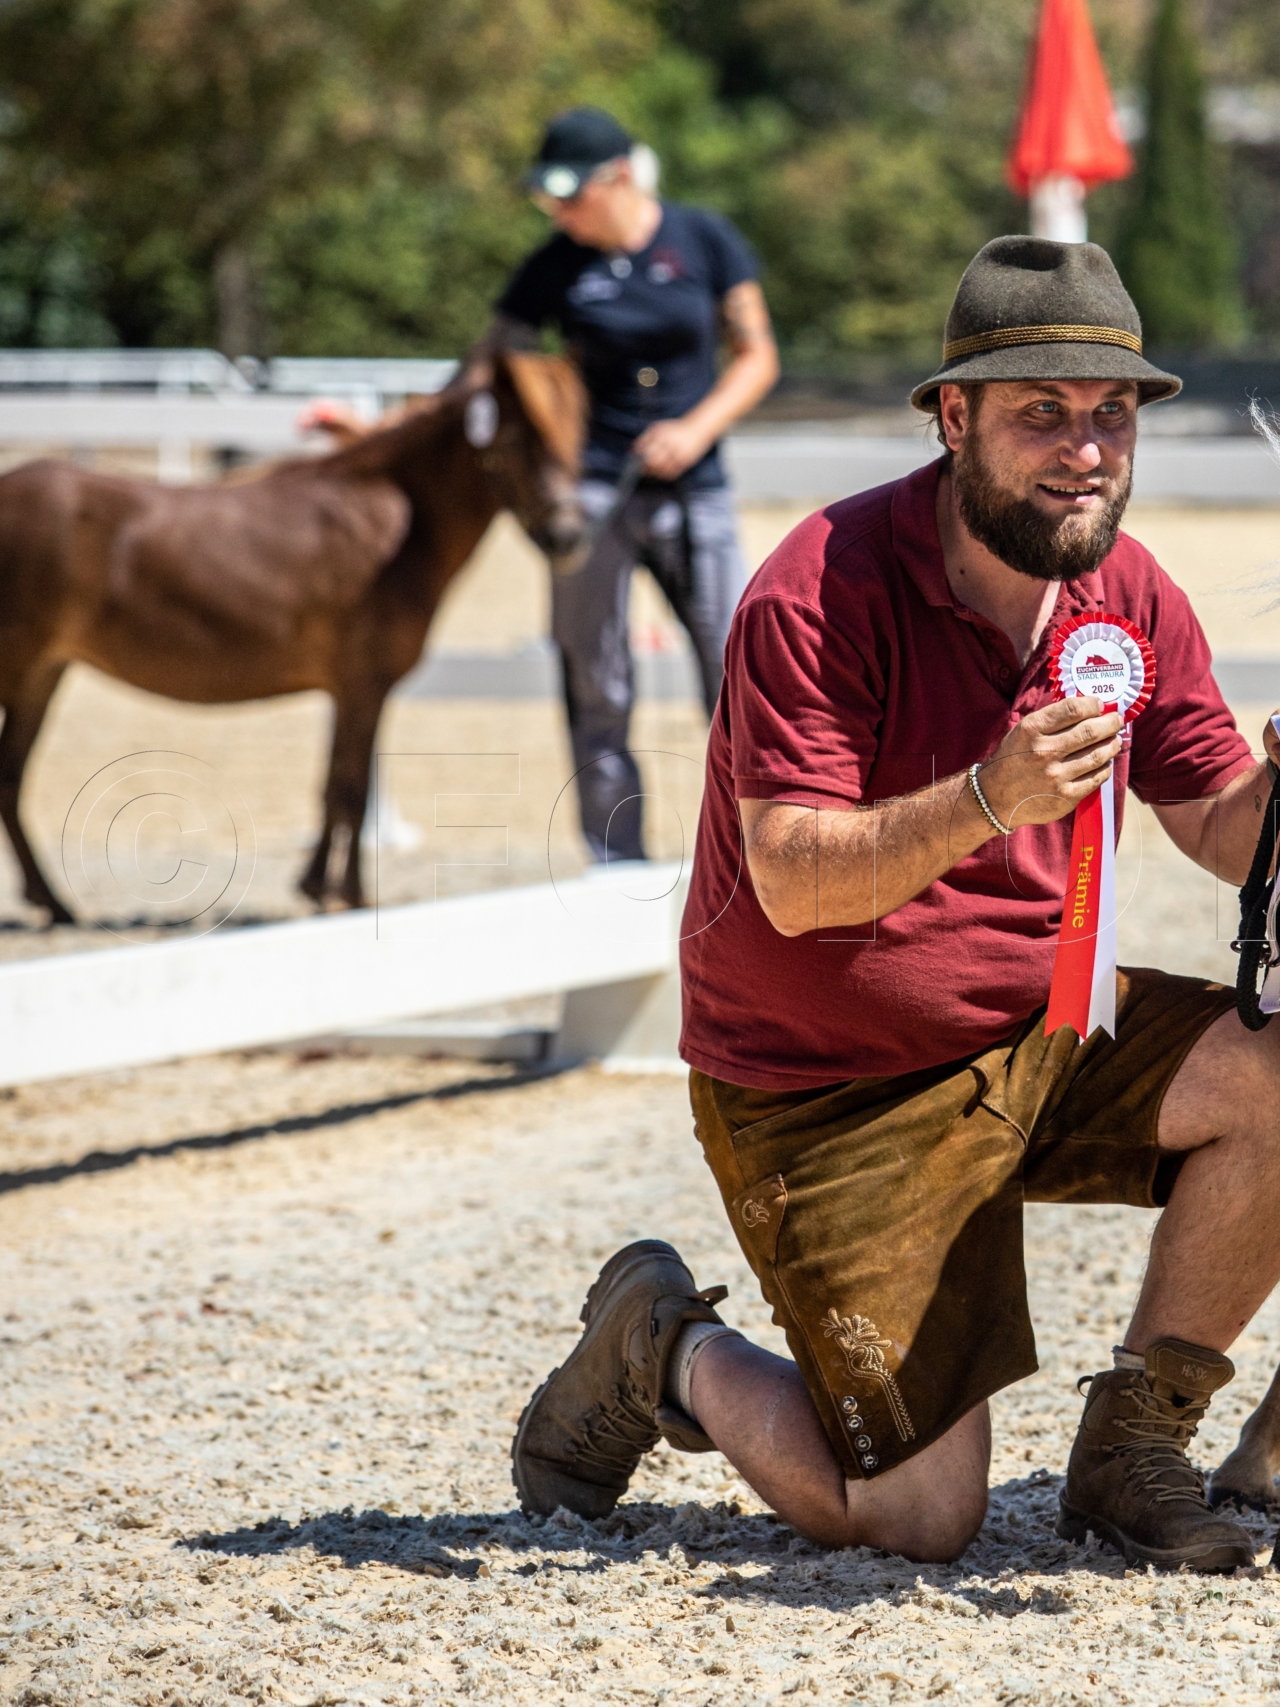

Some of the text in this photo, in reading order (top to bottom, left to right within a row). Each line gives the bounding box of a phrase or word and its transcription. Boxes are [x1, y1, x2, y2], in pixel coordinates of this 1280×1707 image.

[1077, 664, 1123, 673] ZUCHTVERBAND
[1092, 684, 1115, 694] 2026
[1072, 846, 1094, 928] Prämie
